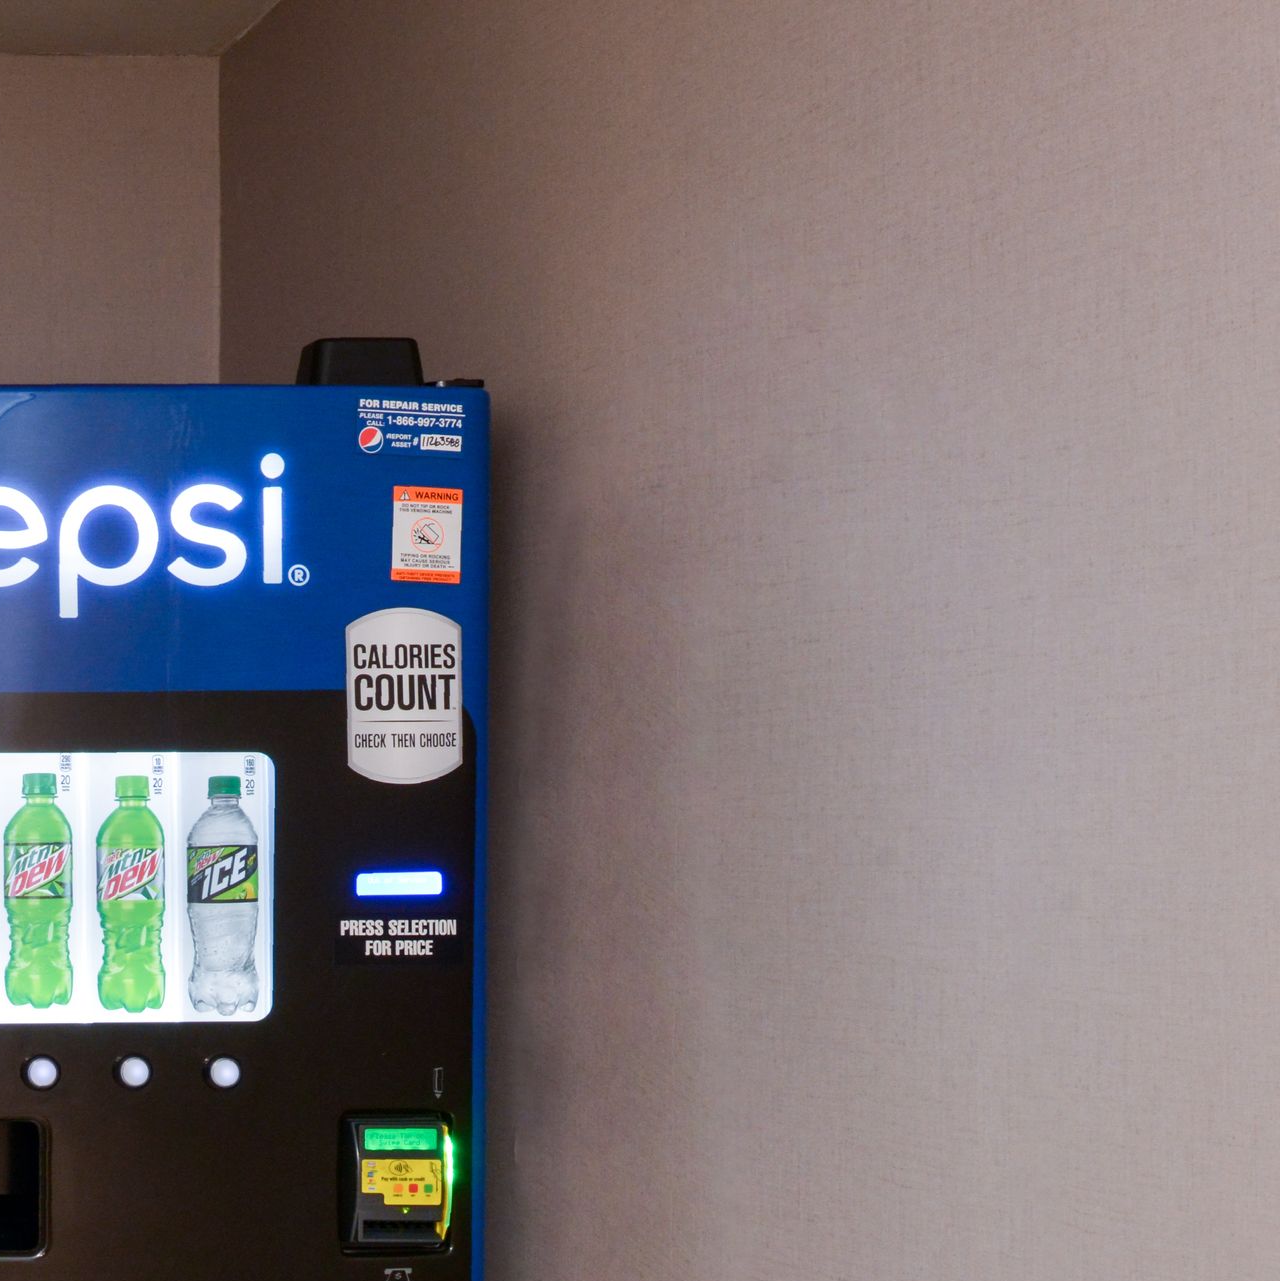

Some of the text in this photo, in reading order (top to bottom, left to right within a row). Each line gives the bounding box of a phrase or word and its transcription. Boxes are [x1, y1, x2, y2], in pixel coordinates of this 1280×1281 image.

[359, 399, 463, 412] FOR REPAIR SERVICE
[386, 415, 462, 428] 1-866-997-3774
[415, 491, 459, 501] WARNING
[353, 643, 456, 669] CALORIES
[354, 673, 456, 711] COUNT
[354, 732, 457, 748] CHECK THEN CHOOSE
[61, 775, 70, 785] 20
[153, 778, 162, 787] 20
[246, 779, 255, 788] 20
[202, 847, 247, 900] ICE
[340, 919, 457, 936] PRESS SELECTION
[365, 940, 433, 956] FOR PRICE
